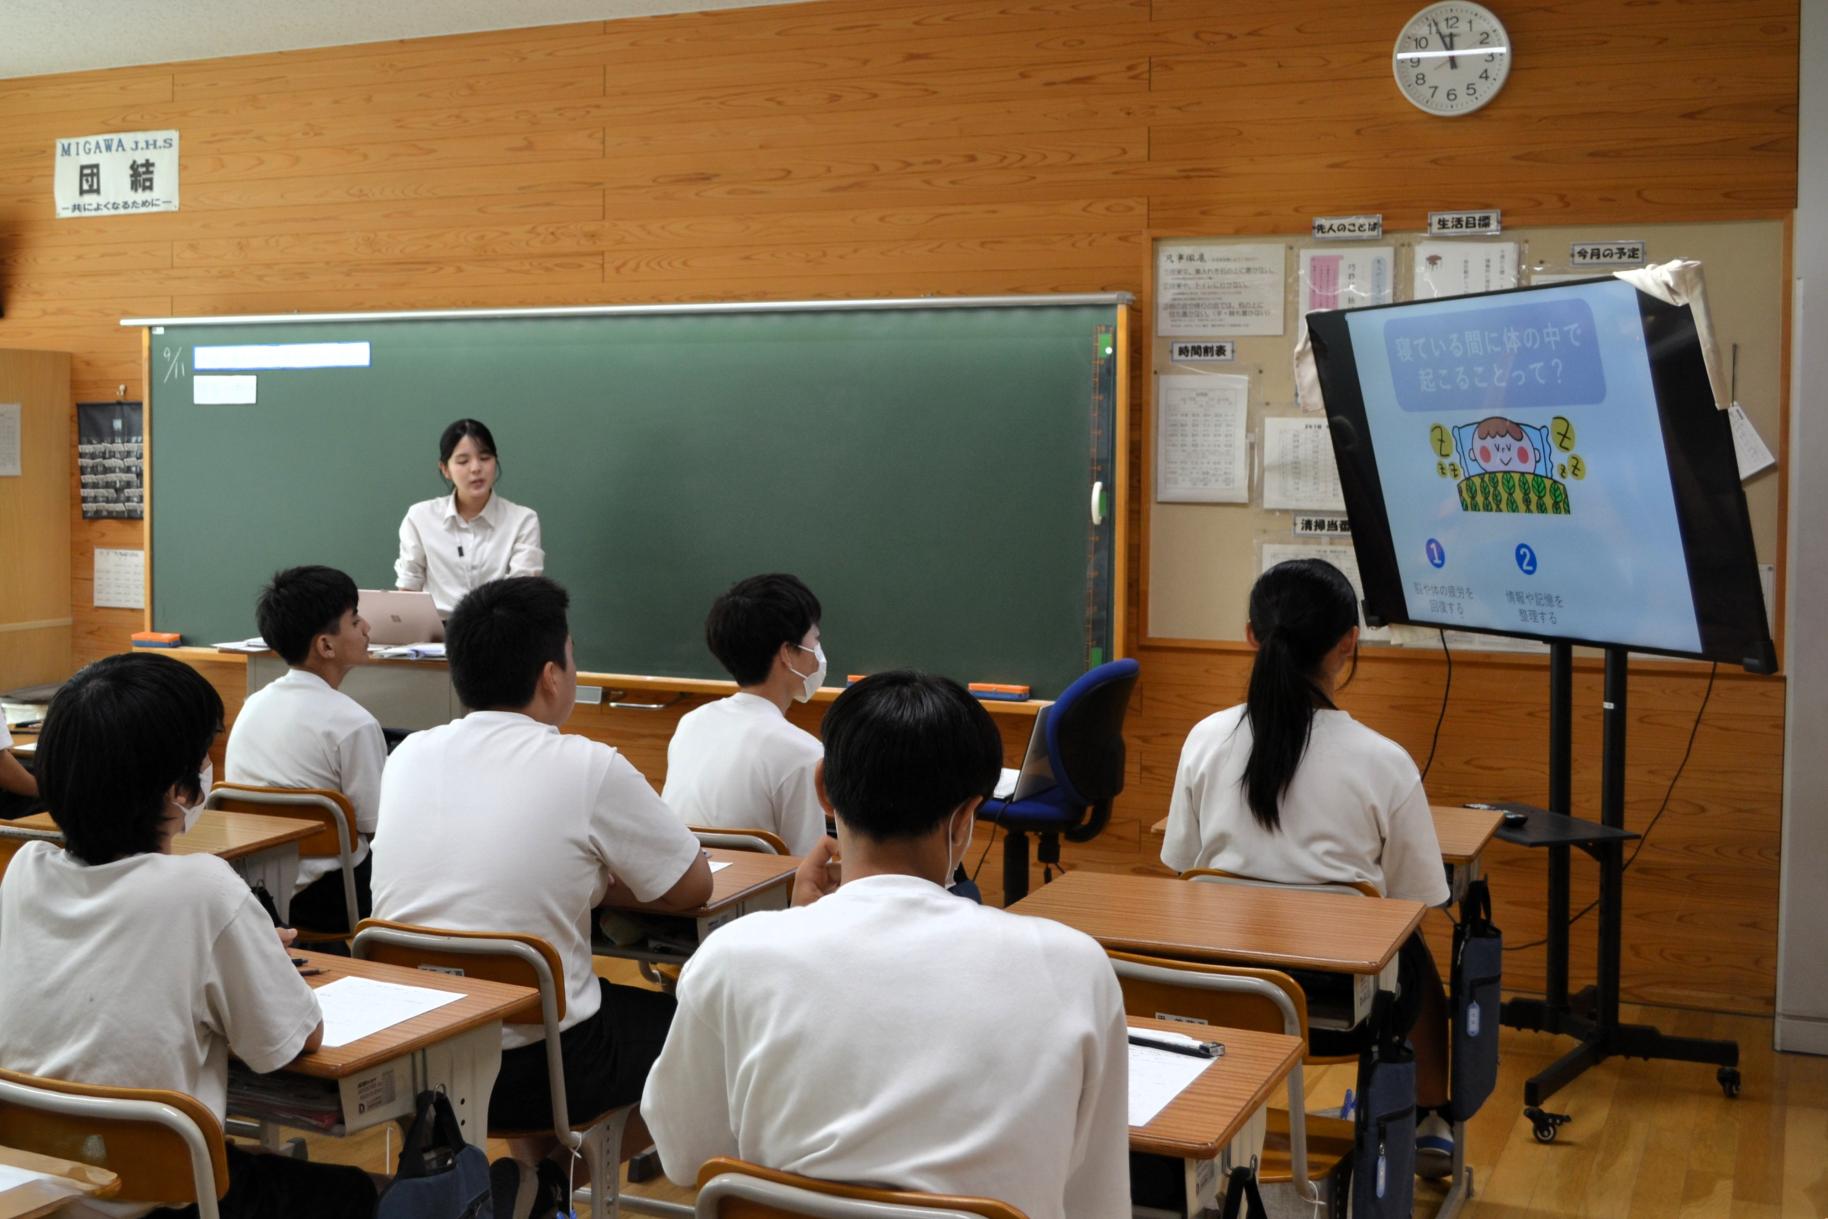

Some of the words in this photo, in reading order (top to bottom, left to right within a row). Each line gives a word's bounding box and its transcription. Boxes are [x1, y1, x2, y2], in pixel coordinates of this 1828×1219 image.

[1444, 16, 1459, 29] 12
[1467, 19, 1473, 32] 1
[1414, 36, 1429, 49] 10
[1480, 31, 1490, 45] 2
[1409, 56, 1420, 68] 9
[1484, 52, 1495, 63] 3
[1415, 73, 1426, 86] 8
[1478, 68, 1490, 81] 4
[1428, 86, 1439, 99] 7
[1446, 89, 1458, 102] 6
[1466, 83, 1477, 96] 5
[60, 138, 126, 157] MIGAWA
[1316, 222, 1377, 234] 先人のことば
[1437, 215, 1491, 230] 生活目標
[1577, 247, 1640, 260] 今月の予定
[1395, 322, 1582, 362] 寝ている間に体の中で
[1178, 345, 1227, 358] 時間割表
[1300, 518, 1351, 532] 清掃当番
